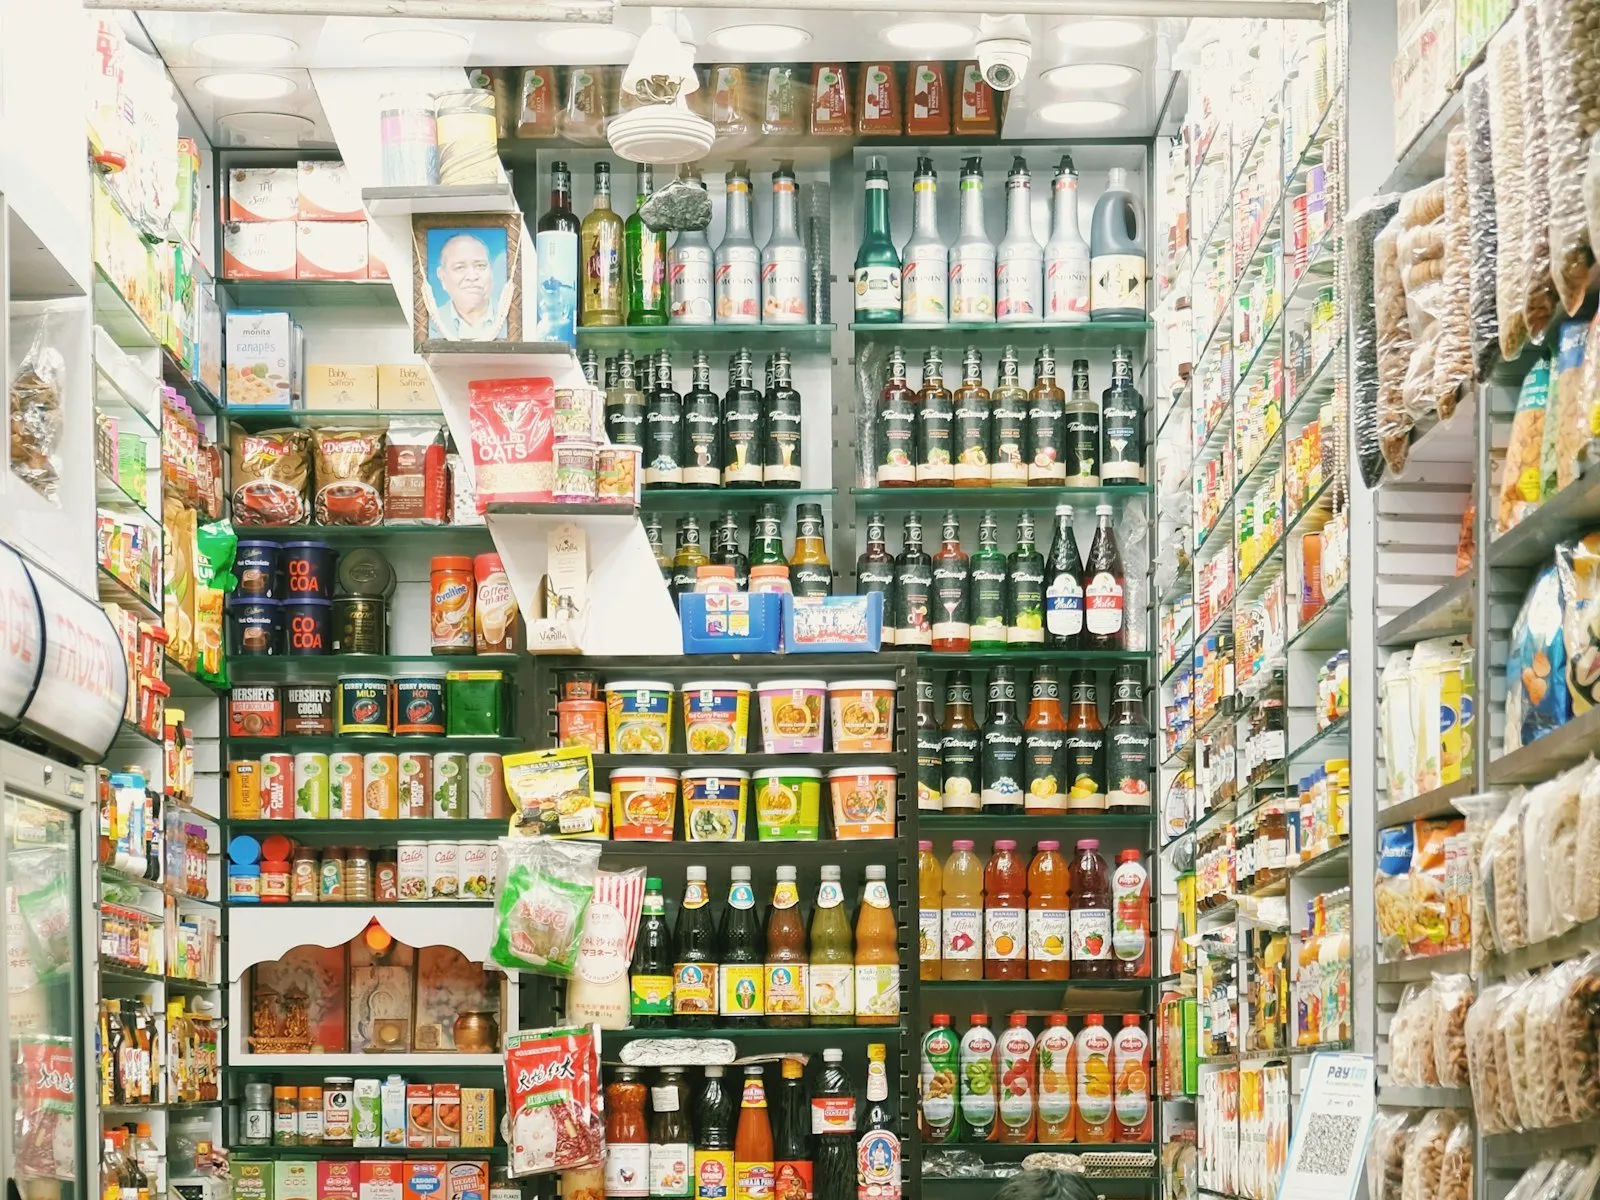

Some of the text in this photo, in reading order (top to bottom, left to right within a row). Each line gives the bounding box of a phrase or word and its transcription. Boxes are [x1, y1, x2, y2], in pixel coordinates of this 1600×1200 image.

[480, 450, 527, 461] OATS
[435, 584, 468, 604] Ovaltine
[232, 688, 274, 700] HERSHEY'S
[288, 690, 331, 702] HERSHEY'S
[356, 690, 376, 698] MILD
[412, 690, 428, 698] HOT
[298, 703, 322, 714] COCOA
[449, 784, 457, 809] BASIL
[400, 849, 423, 862] Catch
[435, 850, 456, 862] Catch
[465, 850, 487, 861] Catch
[929, 1042, 950, 1051] Mapro
[970, 1040, 991, 1050] Mapro
[1008, 1042, 1029, 1051] Mapro
[1046, 1039, 1068, 1047] Mapro
[1086, 1039, 1108, 1048] Mapro
[1121, 1041, 1142, 1049] Mapro
